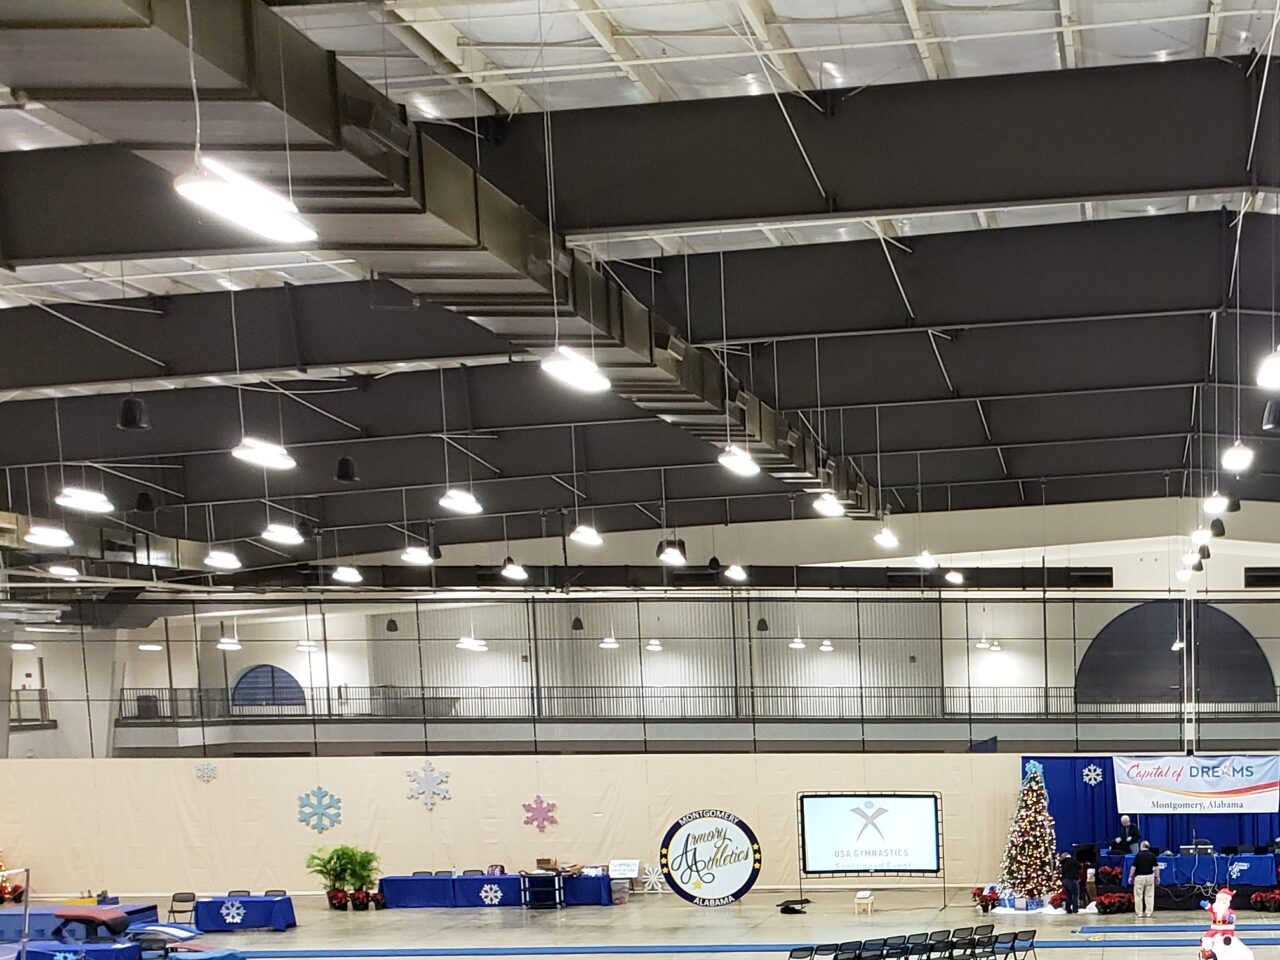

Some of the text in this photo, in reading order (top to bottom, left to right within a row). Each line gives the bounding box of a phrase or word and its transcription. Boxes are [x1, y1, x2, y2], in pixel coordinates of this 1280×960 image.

[1127, 763, 1171, 781] Capital
[1172, 763, 1184, 781] of
[1151, 801, 1244, 810] Montgomery, Alabama
[678, 809, 740, 825] MONTGOMERY
[671, 827, 732, 871] Armory
[834, 848, 909, 858] USA GYMNASTICS
[681, 844, 749, 884] Athletics
[693, 895, 735, 907] ALABAMA
